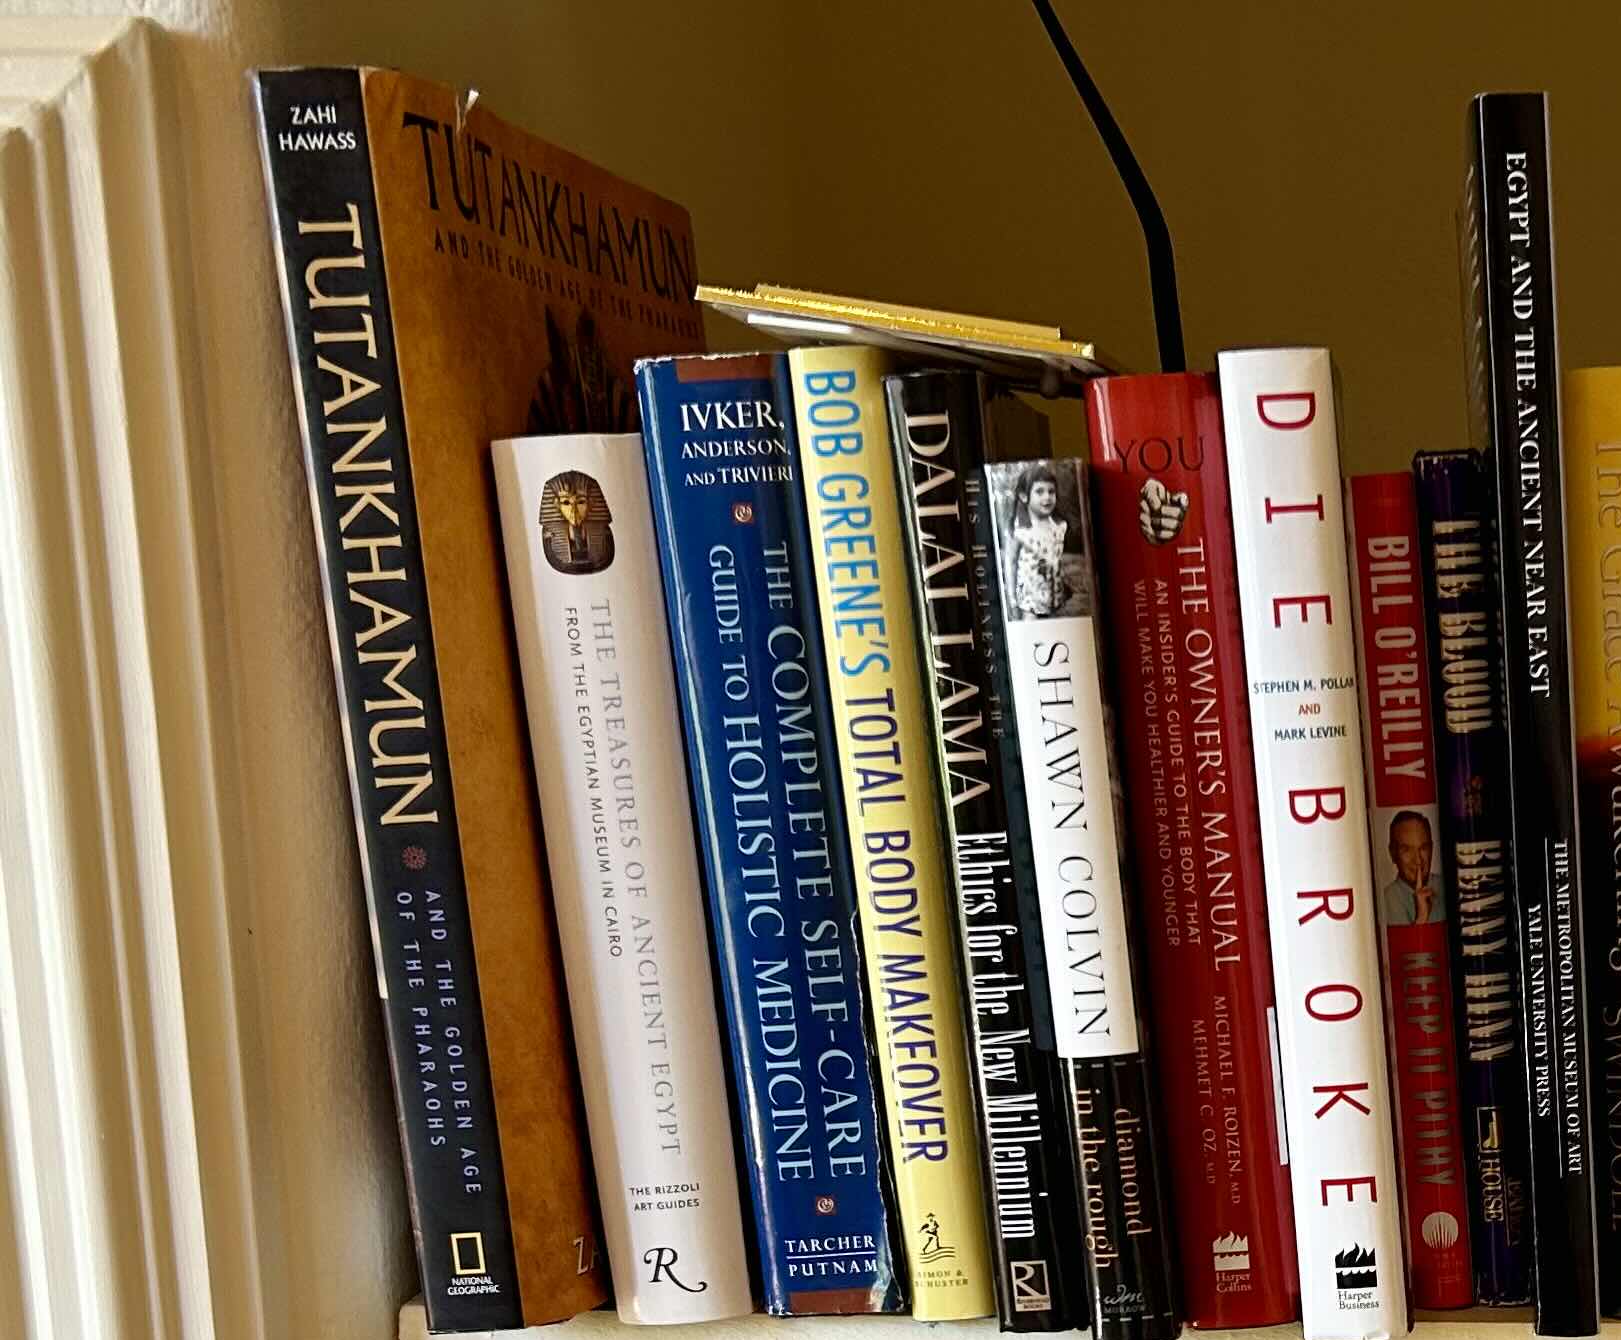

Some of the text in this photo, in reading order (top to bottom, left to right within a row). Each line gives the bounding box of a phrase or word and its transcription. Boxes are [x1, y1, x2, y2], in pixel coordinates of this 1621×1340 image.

[279, 132, 357, 152] HAWASS
[291, 105, 337, 127] ZAHI
[402, 112, 695, 300] TUTANKHAMUN
[680, 402, 785, 432] IVKER,
[681, 439, 790, 459] ANDERSON,
[1505, 151, 1550, 699] EGYPT AND THE ANCIENT NEAR EAST
[298, 204, 439, 826] TUTANKHAMUN
[1367, 536, 1427, 779] BILL O'REILLY
[805, 370, 947, 1164] BOB GREENE'S TOTAL BODY MAKEOVER
[1033, 640, 1110, 1038] SHAWN COLVIN
[1176, 538, 1240, 971] THE OWNER'S MANUAL
[1257, 392, 1378, 1207] DIE BROKE
[709, 546, 814, 1182] GUIDE TO HOLISTIC MEDICINE
[763, 542, 866, 1178] THE COMPLETE SELF-CARE
[629, 1183, 700, 1197] THE RIZZOLI
[633, 1198, 700, 1212] ART GUIDES
[785, 1235, 876, 1255] TARCHER
[1113, 1106, 1151, 1237] diamond
[788, 1258, 879, 1276] PUTNAM
